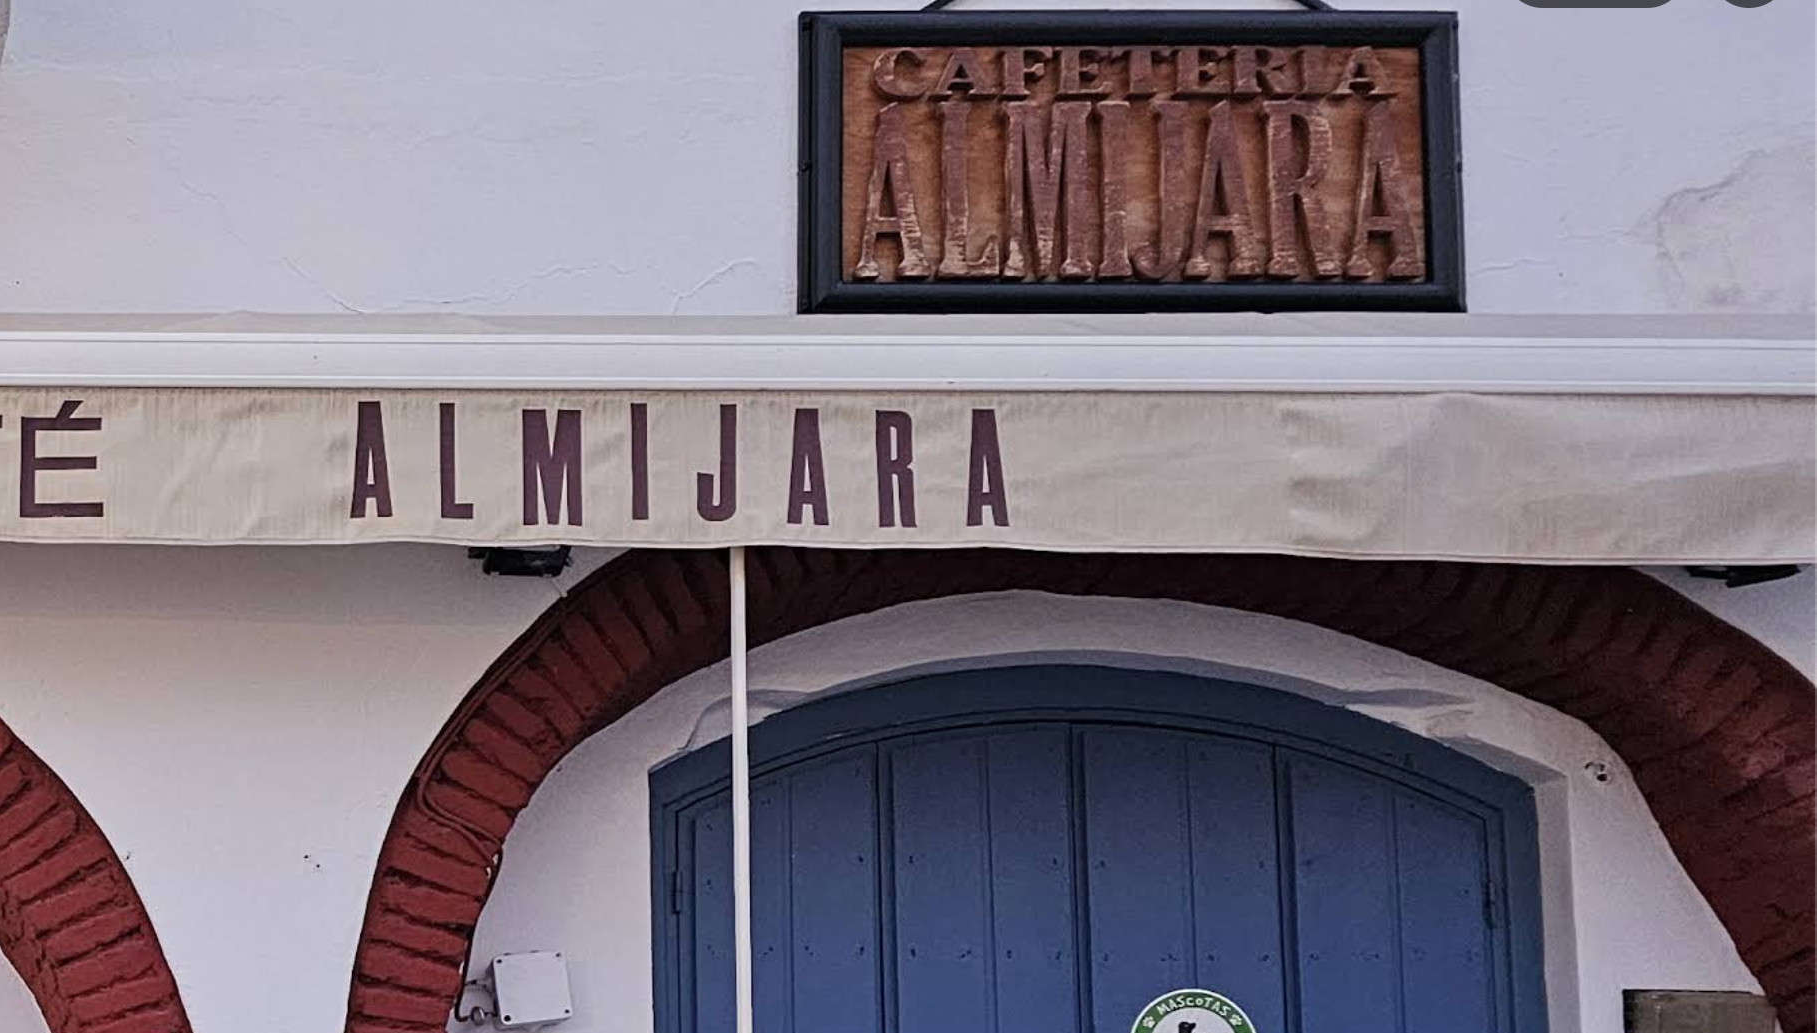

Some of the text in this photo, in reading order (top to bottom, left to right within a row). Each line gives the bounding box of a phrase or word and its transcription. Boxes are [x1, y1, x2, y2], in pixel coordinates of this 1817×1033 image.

[873, 46, 1395, 98] CAFETERIA
[854, 99, 1423, 281] ALMIJARA
[350, 401, 1010, 528] ALMIJARA
[1157, 996, 1231, 1015] MASCOTAS
